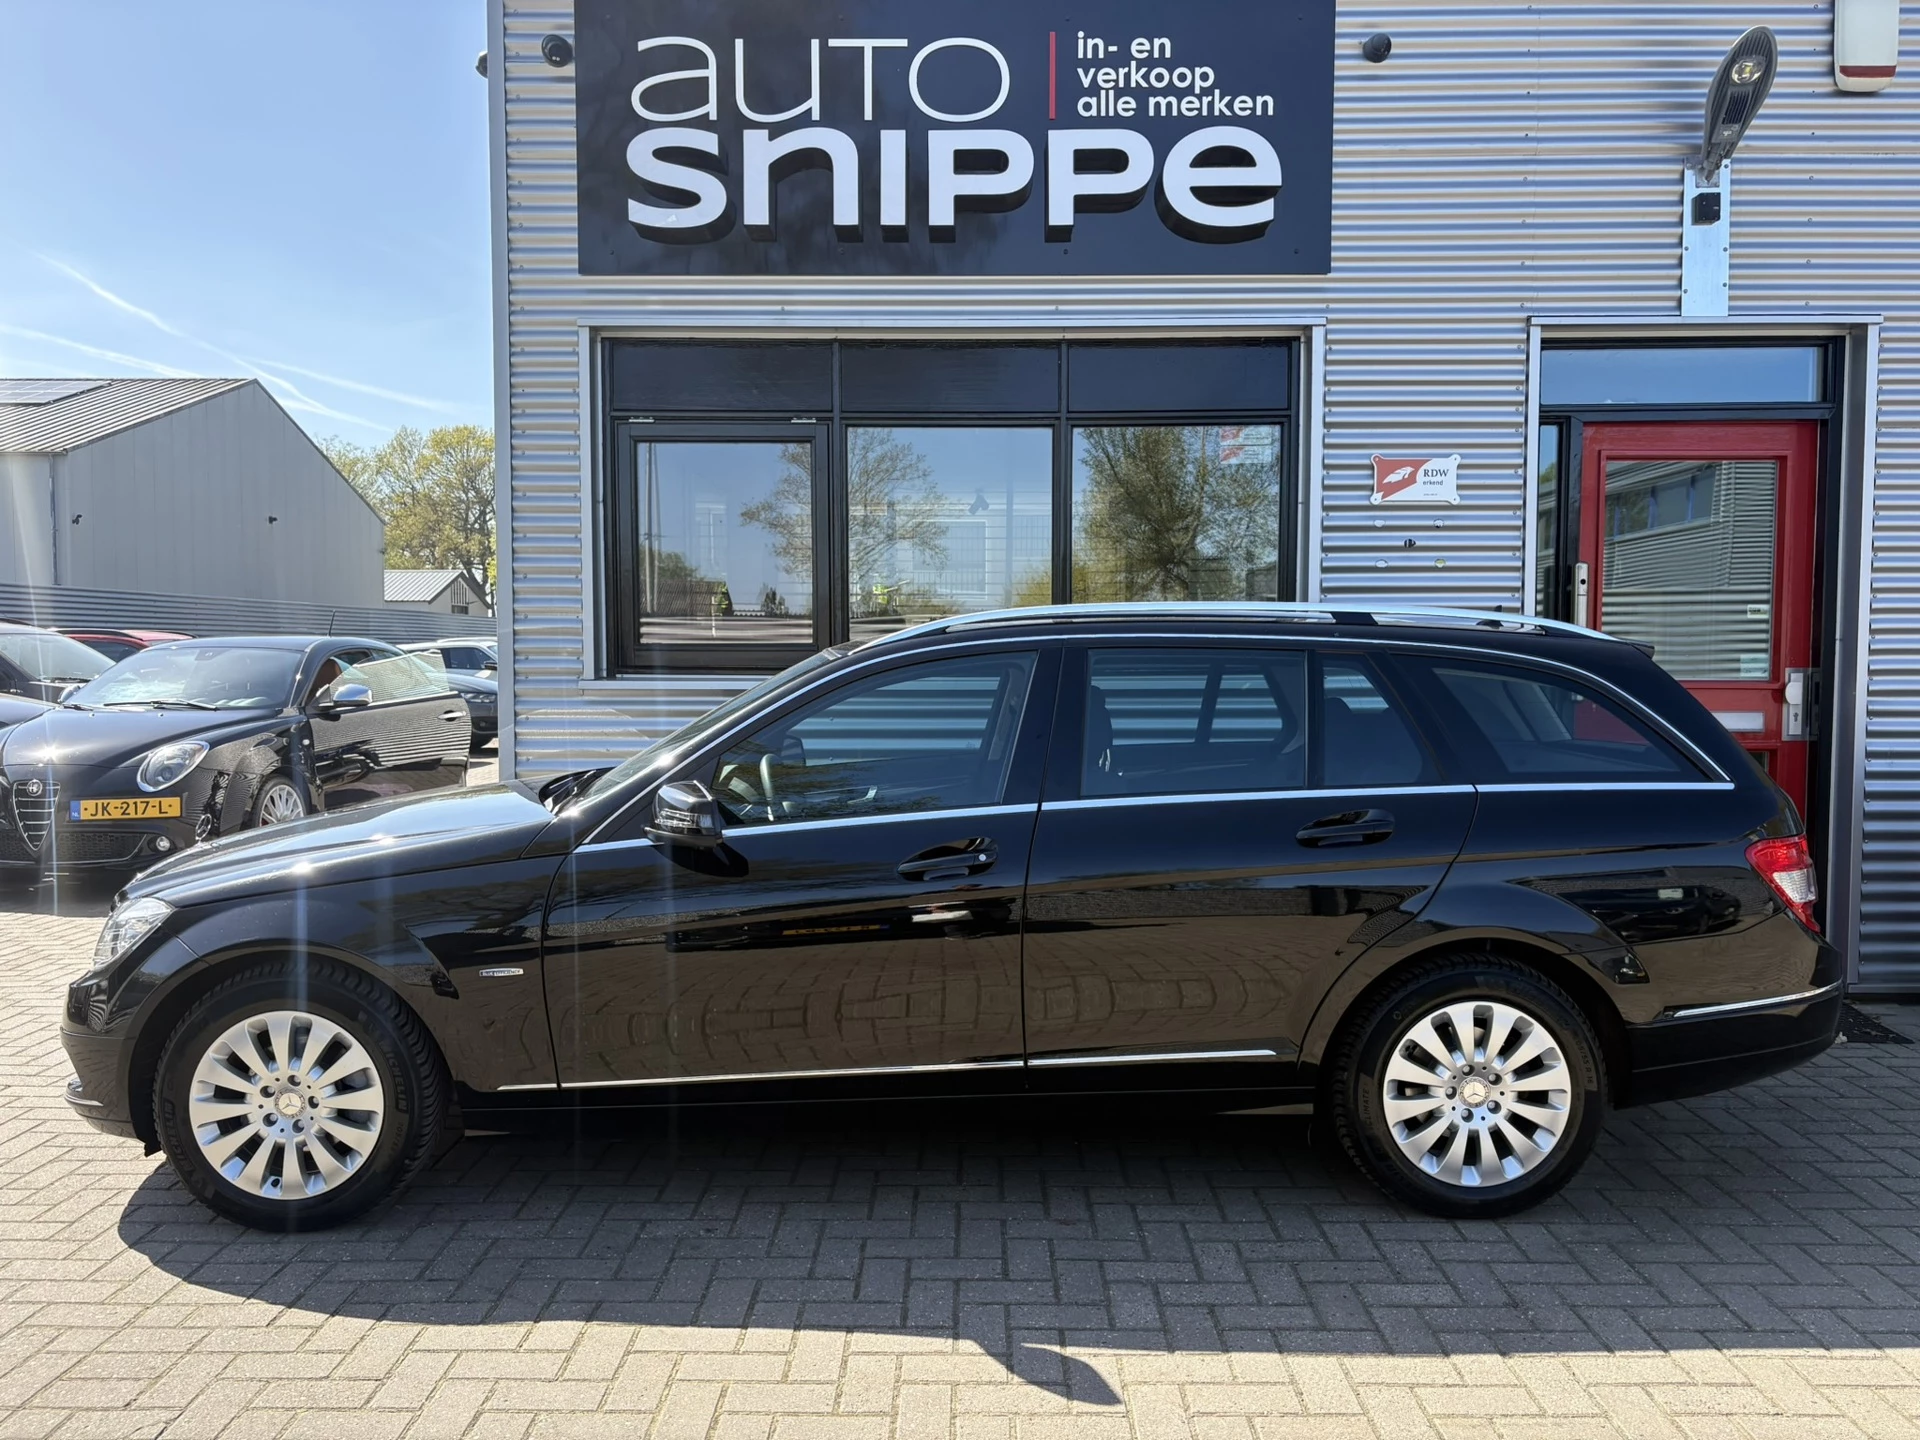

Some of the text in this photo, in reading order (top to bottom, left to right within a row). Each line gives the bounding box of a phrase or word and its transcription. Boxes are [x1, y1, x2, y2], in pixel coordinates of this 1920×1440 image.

[1077, 30, 1171, 59] in- en
[1076, 60, 1215, 94] verkoop
[1077, 89, 1274, 117] alle merken
[1423, 469, 1449, 477] RDW
[90, 800, 168, 817] JK-217-L
[378, 1039, 408, 1111] MICHELIN
